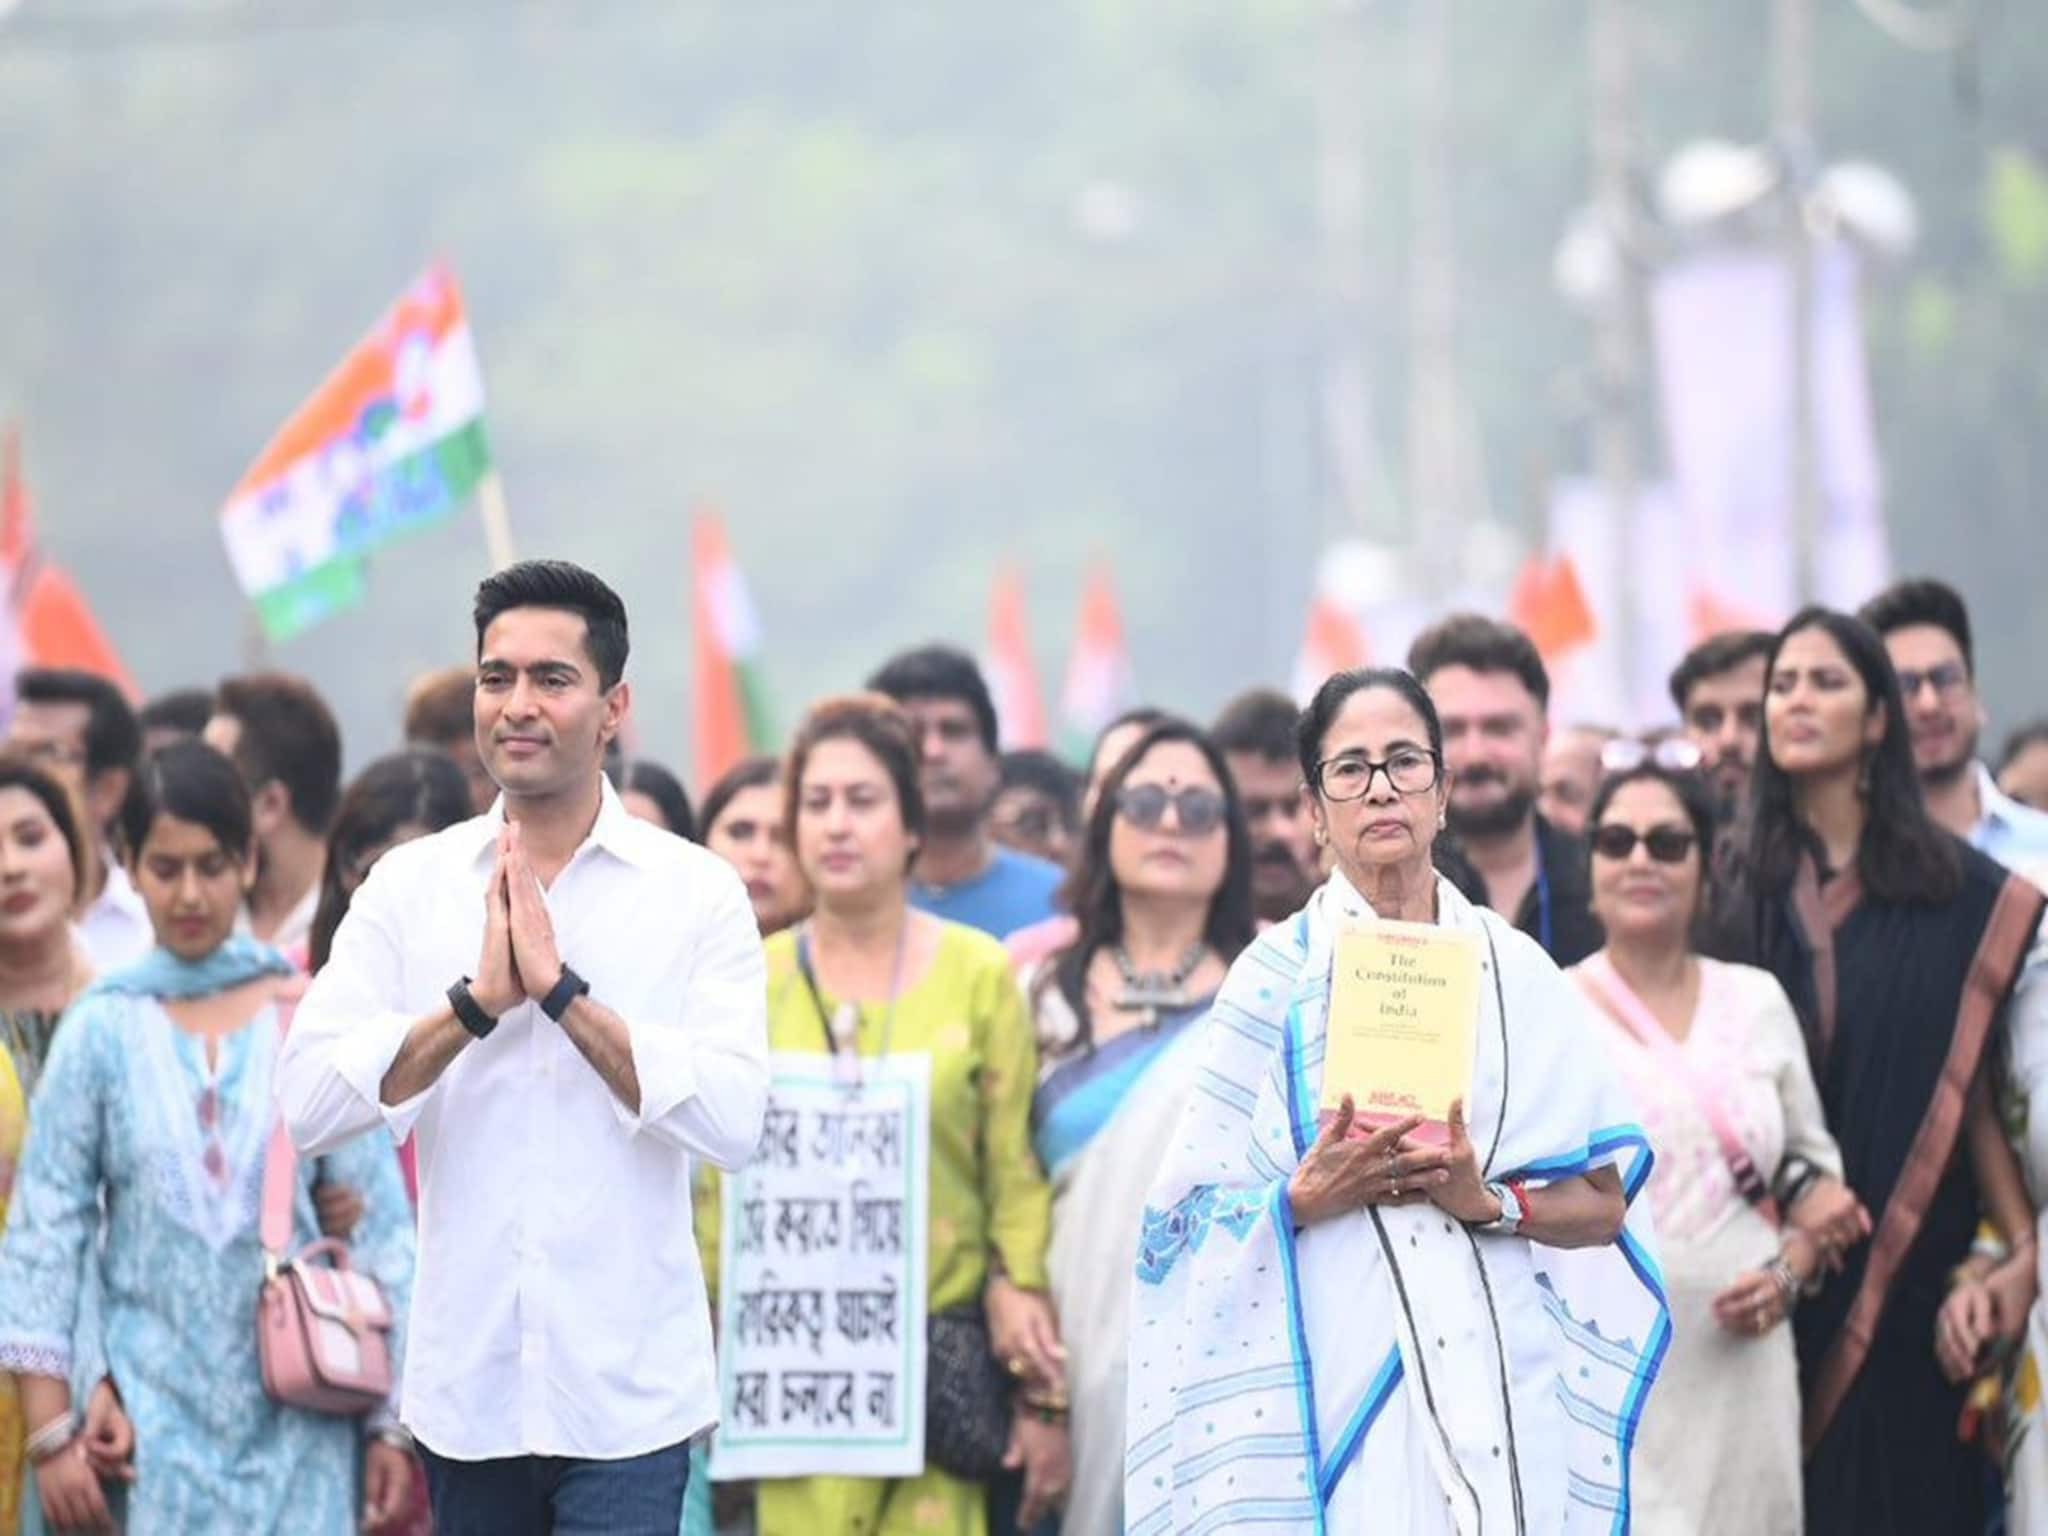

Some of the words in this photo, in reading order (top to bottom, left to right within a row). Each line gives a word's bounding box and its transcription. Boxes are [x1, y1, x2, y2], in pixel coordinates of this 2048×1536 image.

[1388, 953, 1417, 968] The
[1354, 968, 1447, 987] Constitution
[1391, 988, 1407, 1000] of
[1379, 1001, 1418, 1017] India
[774, 1197, 839, 1254] করতে
[781, 1371, 855, 1427] চলবে
[866, 1371, 896, 1427] না
